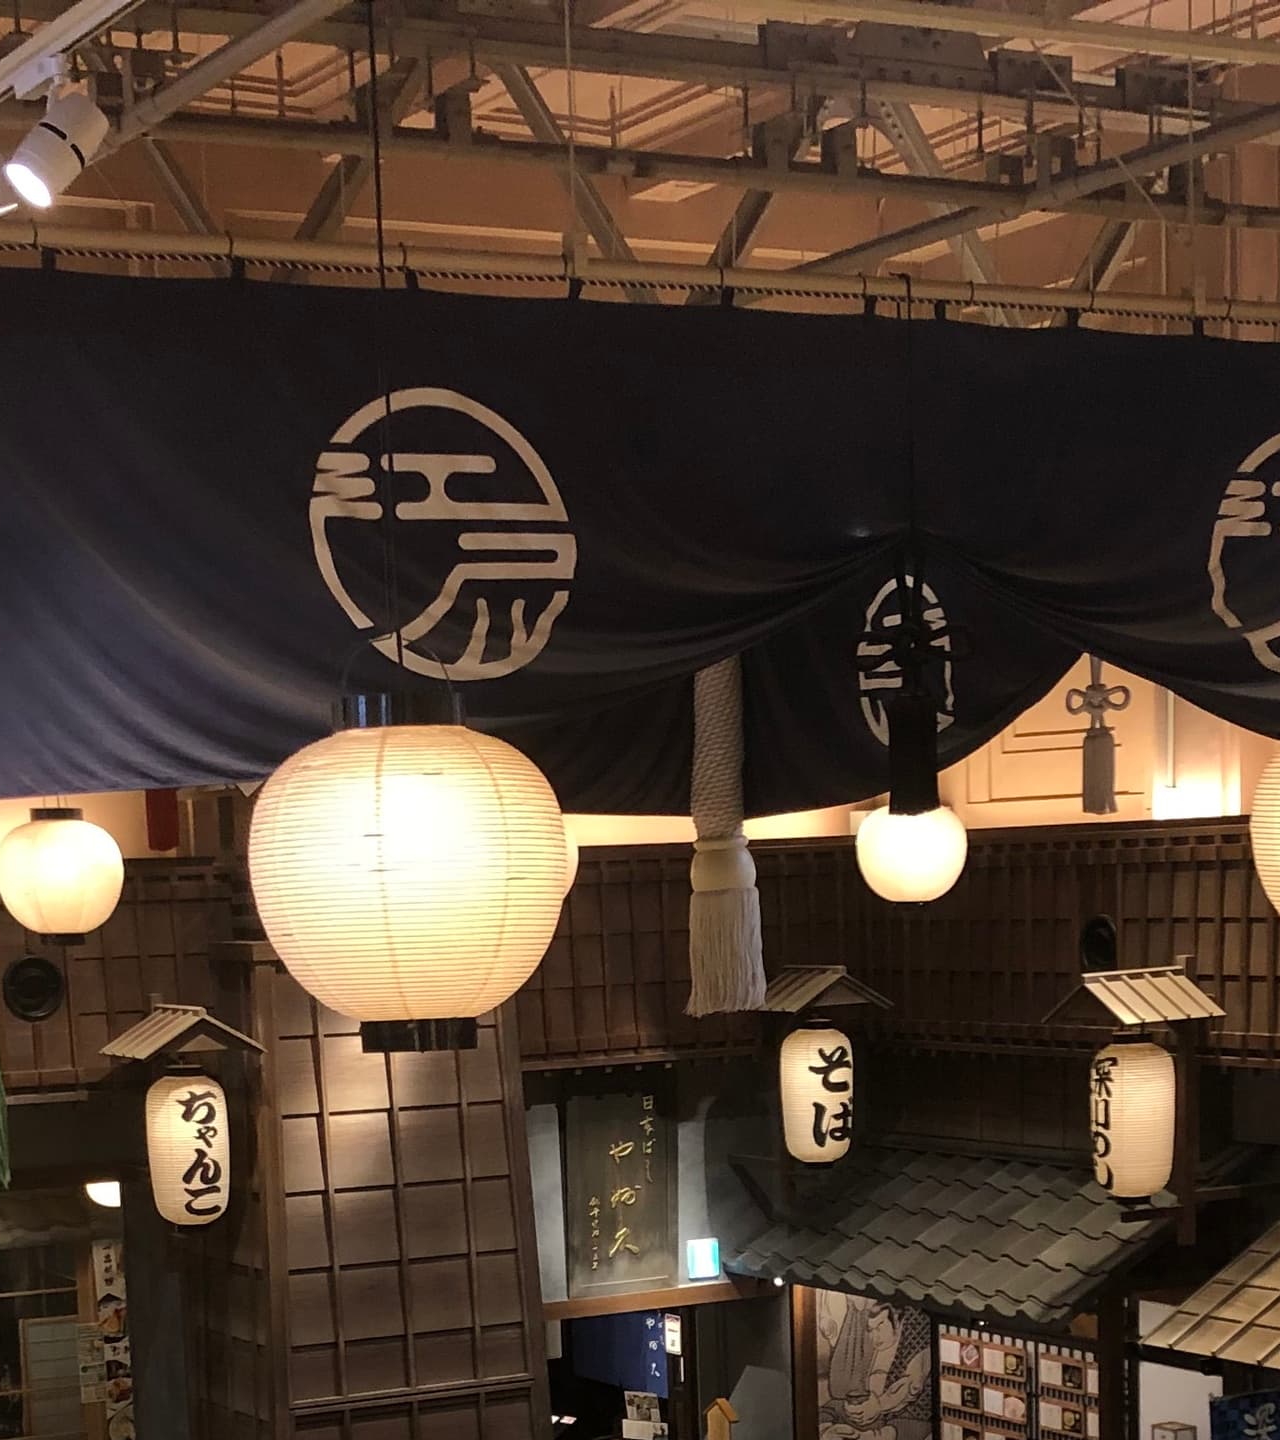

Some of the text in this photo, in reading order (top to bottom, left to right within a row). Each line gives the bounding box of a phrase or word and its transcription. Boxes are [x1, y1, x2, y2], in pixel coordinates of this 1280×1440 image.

[809, 1046, 854, 1147] そば
[176, 1091, 223, 1217] ちゃんこ
